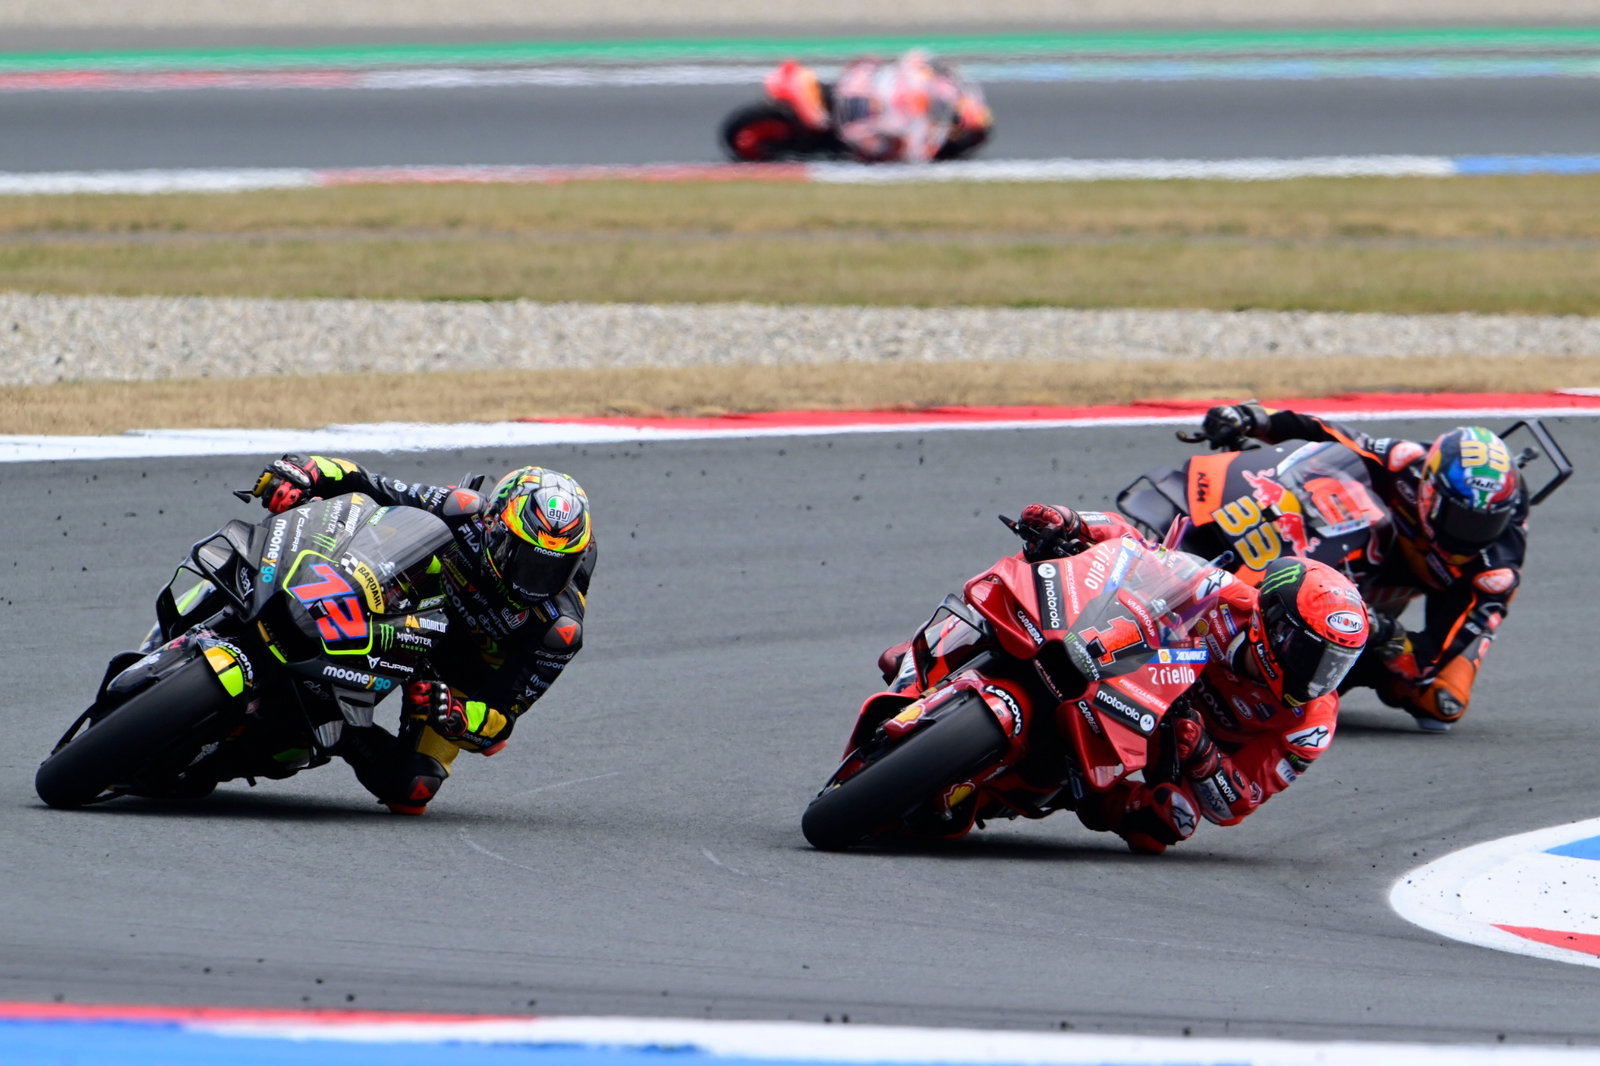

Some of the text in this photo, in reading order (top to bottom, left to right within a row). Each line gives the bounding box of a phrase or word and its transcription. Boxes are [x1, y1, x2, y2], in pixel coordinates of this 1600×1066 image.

[549, 509, 569, 520] agv
[261, 518, 287, 584] mooneygo
[291, 517, 305, 553] CUPRA
[458, 523, 480, 553] FILA
[1212, 495, 1282, 571] 33
[534, 546, 565, 558] mooney
[288, 562, 368, 643] 72
[357, 565, 382, 610] BARDAHL
[1043, 579, 1061, 629] motorola
[1017, 610, 1043, 648] CARRERA
[1126, 598, 1156, 638] VARGROUP
[396, 631, 432, 648] MONSTER
[1078, 615, 1144, 668] 1
[323, 665, 392, 691] mooneygo
[379, 660, 415, 674] CUPRA
[1159, 666, 1196, 685] riello
[1255, 643, 1277, 679] Lenovo
[982, 685, 1022, 737] Lenovo
[1096, 689, 1141, 722] motorola
[1214, 770, 1237, 802] Lenovo
